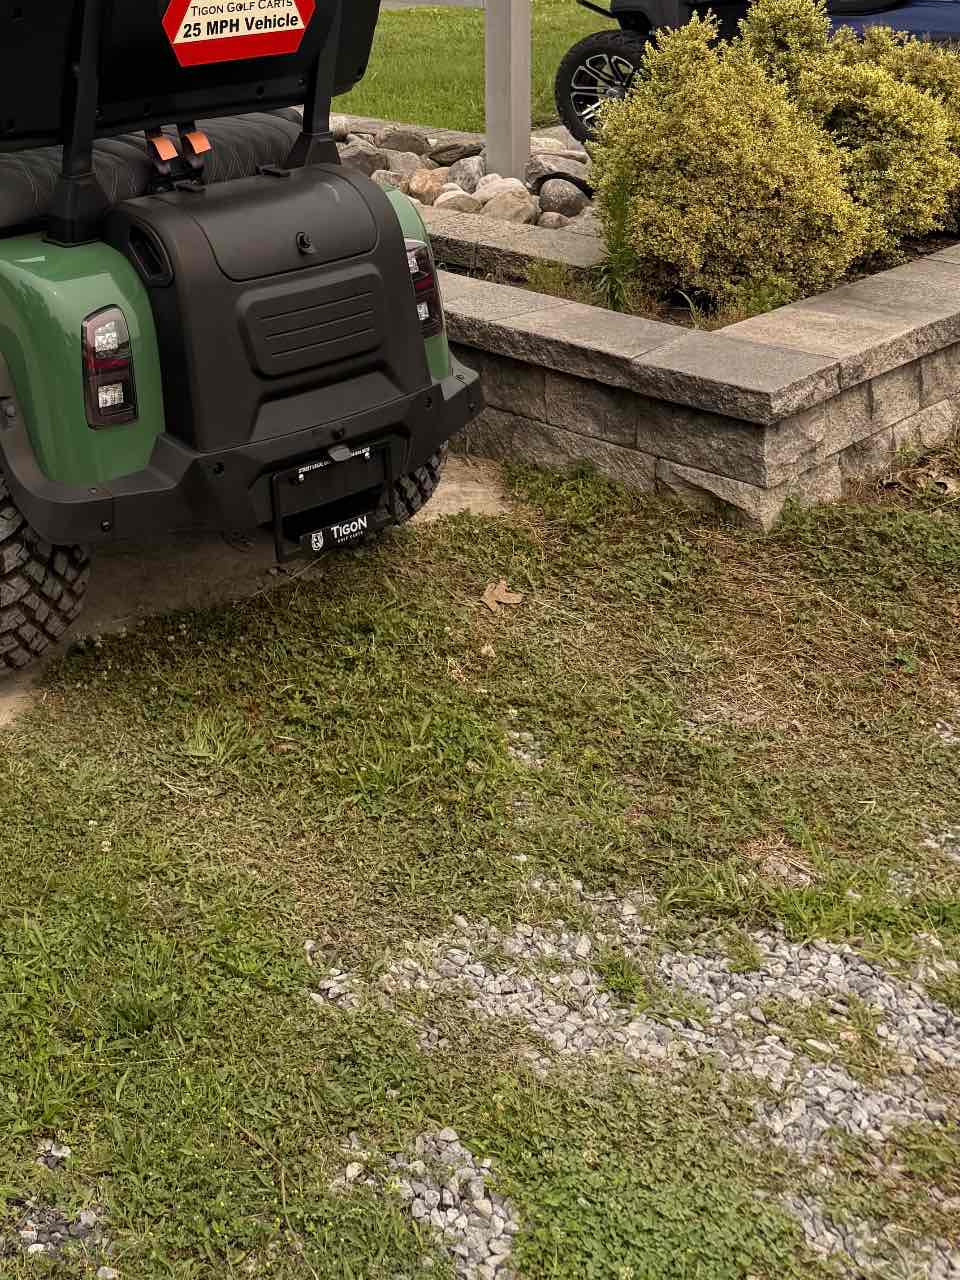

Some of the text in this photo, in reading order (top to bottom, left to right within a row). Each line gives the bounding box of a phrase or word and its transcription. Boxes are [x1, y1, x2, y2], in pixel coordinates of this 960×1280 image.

[191, 4, 224, 17] TIGON
[227, 1, 256, 13] GOLF
[183, 13, 299, 38] 25 MPH Vehicle
[330, 515, 368, 539] TIGON
